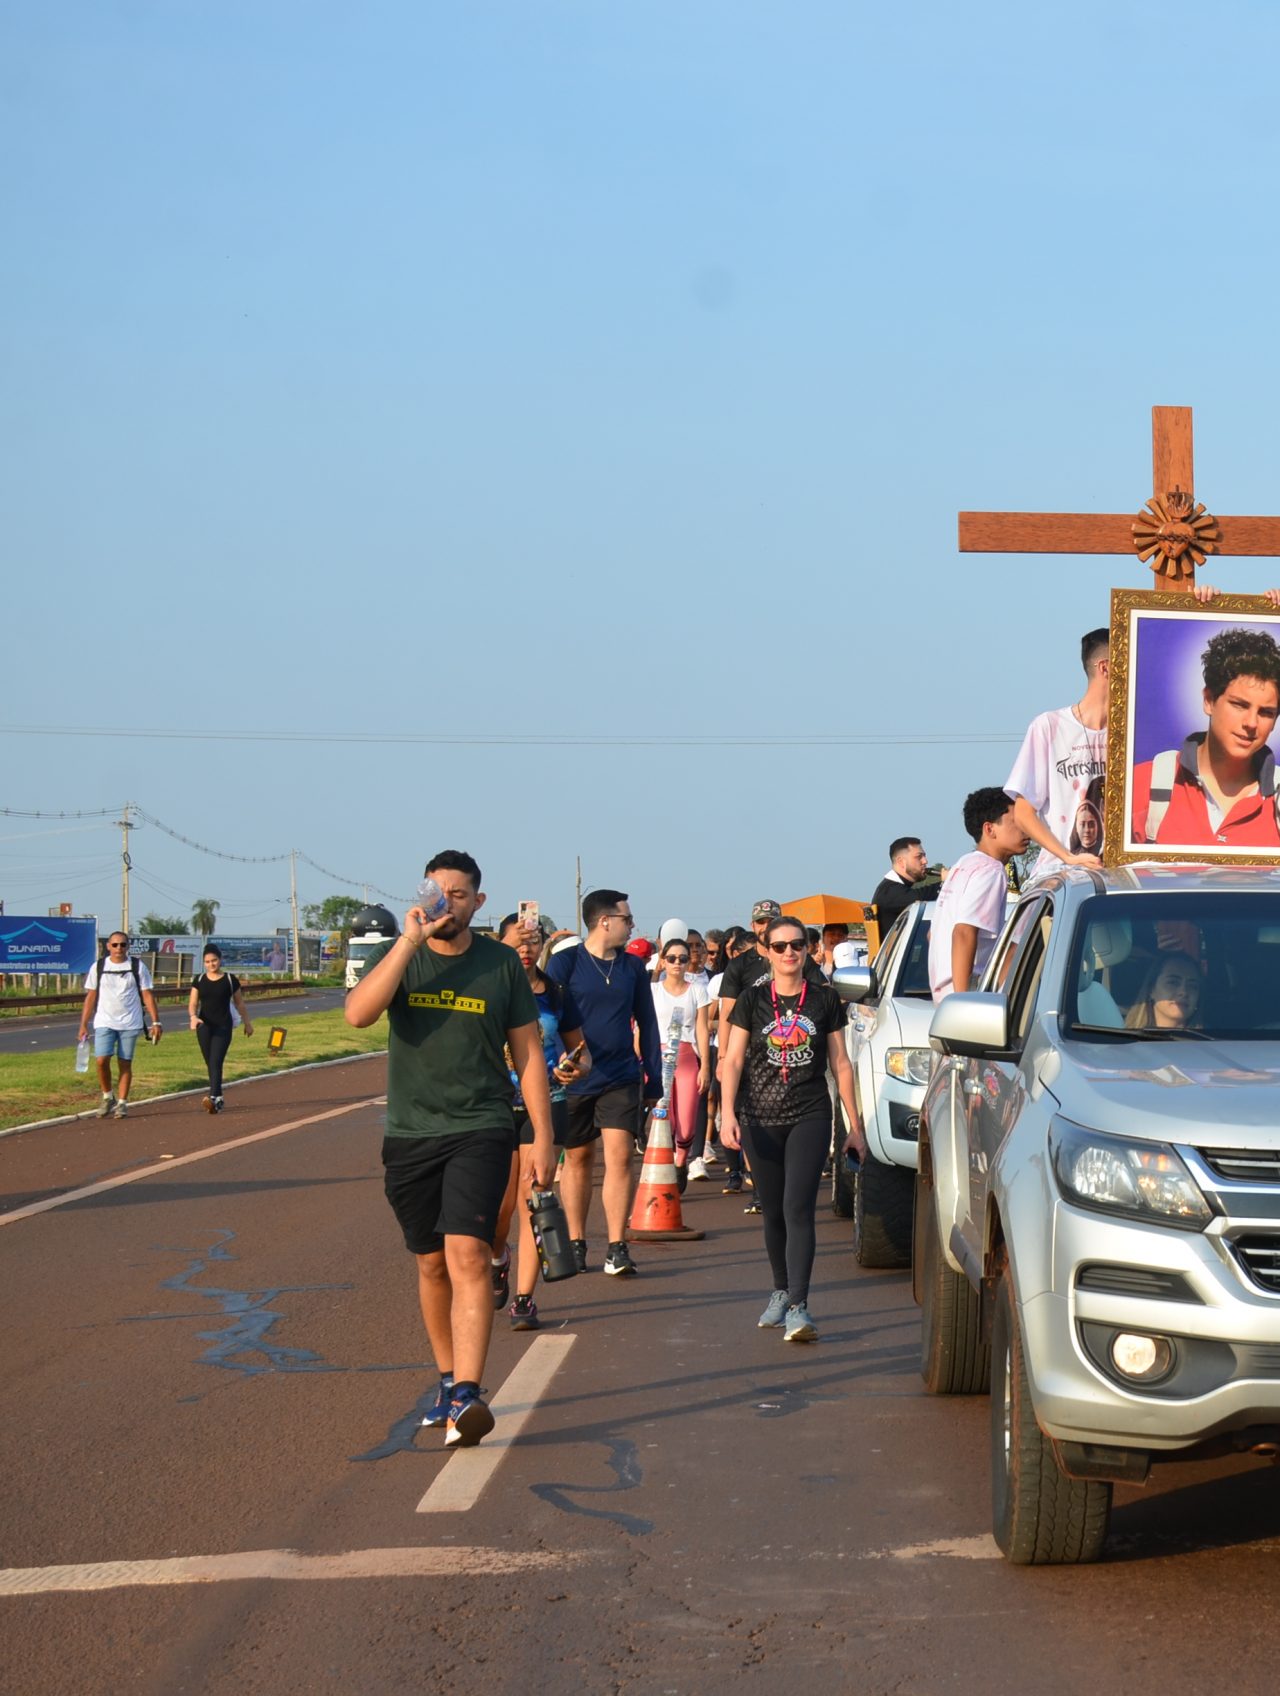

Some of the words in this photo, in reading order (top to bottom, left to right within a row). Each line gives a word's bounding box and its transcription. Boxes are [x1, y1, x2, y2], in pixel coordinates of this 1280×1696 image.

[1056, 753, 1106, 780] Teresinh
[8, 945, 61, 953] DUNAMIS
[775, 1046, 814, 1063] JSUS
